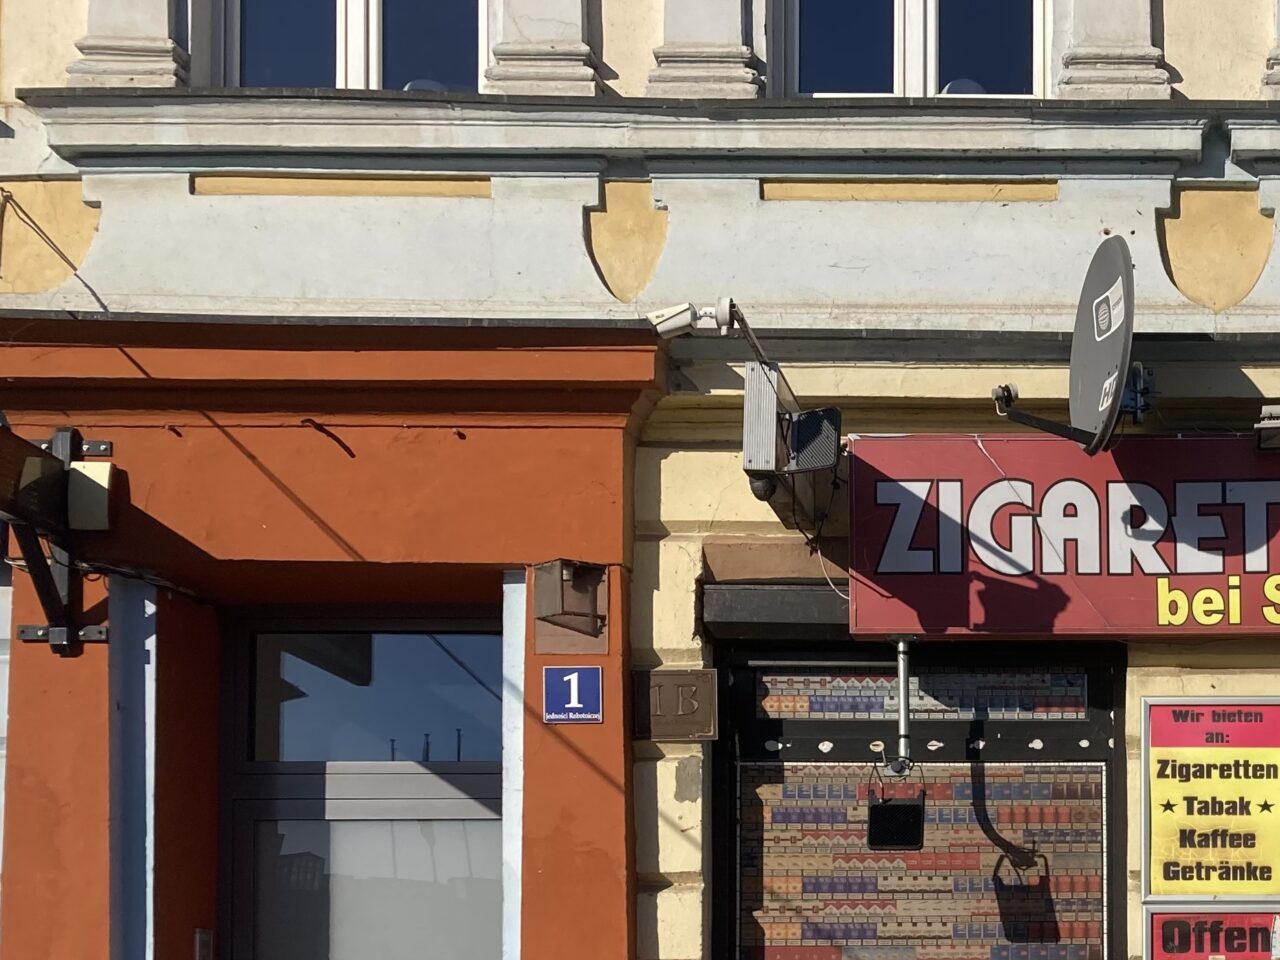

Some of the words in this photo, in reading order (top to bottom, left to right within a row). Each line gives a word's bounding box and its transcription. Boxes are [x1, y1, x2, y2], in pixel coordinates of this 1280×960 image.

[1156, 574, 1241, 626] bei
[563, 671, 583, 708] 1
[1172, 709, 1204, 723] Wir
[1211, 709, 1264, 723] bieten
[1205, 731, 1230, 744] an:
[1156, 759, 1279, 783] Zigaretten
[1183, 796, 1252, 816] Tabak
[1179, 828, 1256, 849] Kaffee
[1162, 861, 1273, 881] Getränke
[1161, 919, 1272, 953] Offen
